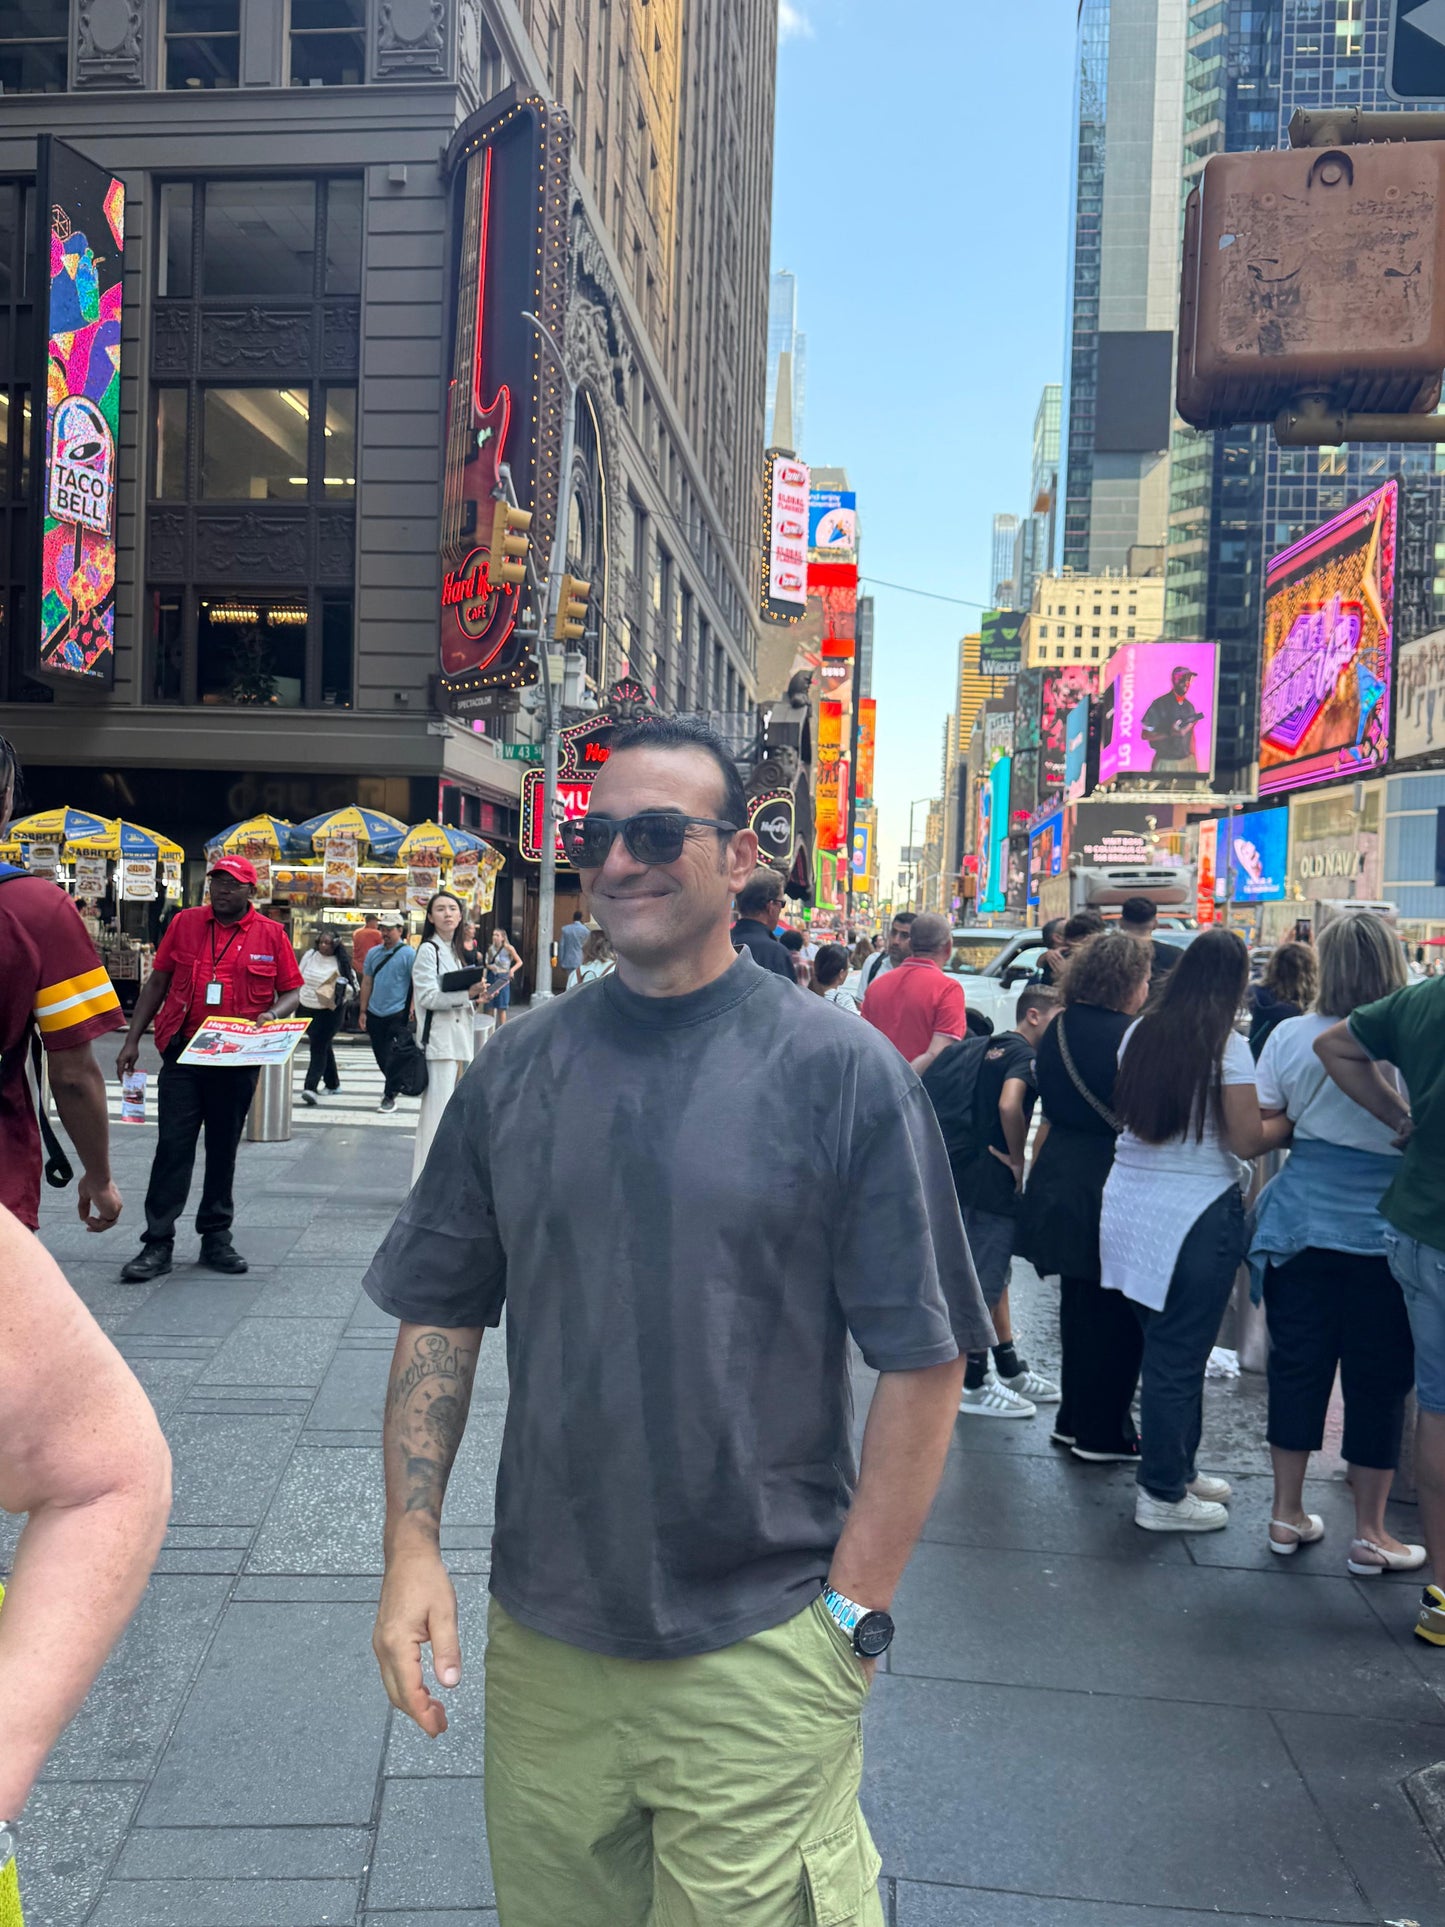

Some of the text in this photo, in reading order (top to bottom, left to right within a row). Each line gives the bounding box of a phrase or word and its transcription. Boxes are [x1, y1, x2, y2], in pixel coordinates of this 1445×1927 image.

[55, 464, 105, 498] TACO
[57, 487, 102, 521] BELL
[441, 567, 477, 607] Hard
[465, 603, 487, 622] CAFE
[457, 695, 493, 710] SPECTACOLOR
[1119, 673, 1134, 738] xboom
[505, 745, 515, 758] W
[518, 745, 531, 758] 43
[584, 742, 611, 763] Ha
[1118, 743, 1132, 767] LG
[557, 791, 592, 810] MU
[1107, 853, 1148, 862] BROADWA
[1301, 858, 1323, 879] OLD
[207, 1021, 244, 1032] Hop-On
[283, 1022, 305, 1031] Pass
